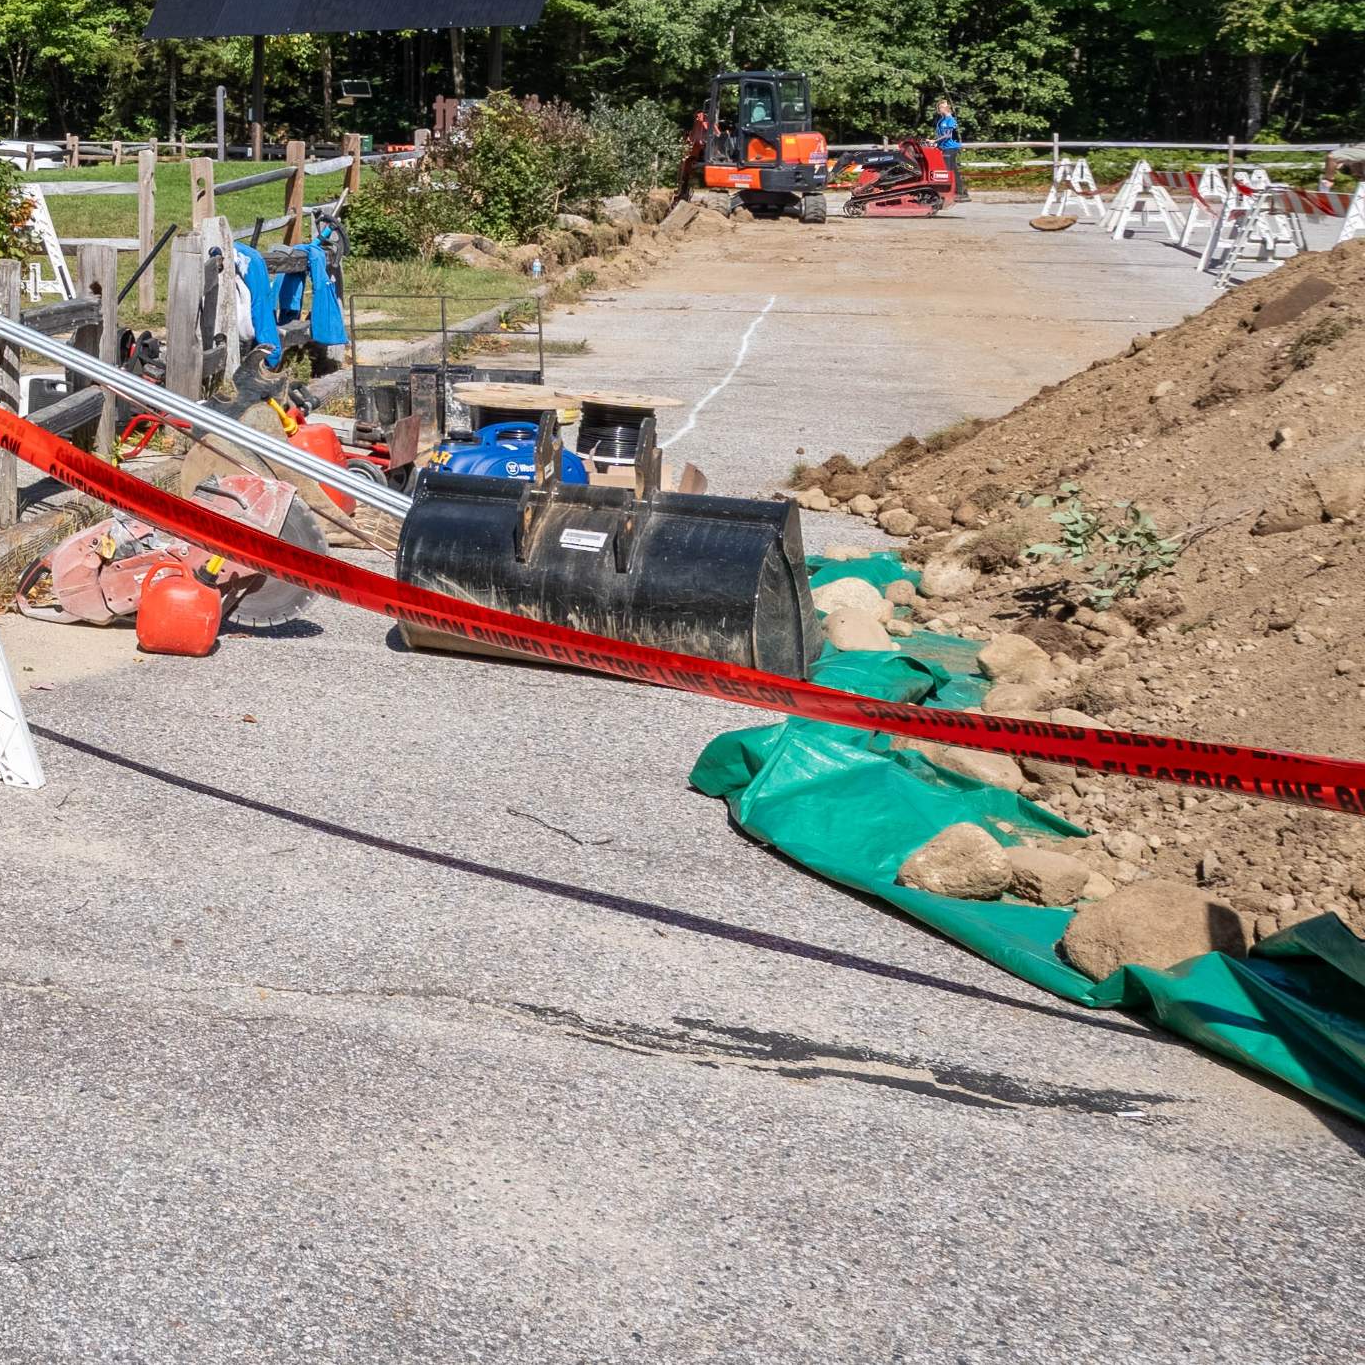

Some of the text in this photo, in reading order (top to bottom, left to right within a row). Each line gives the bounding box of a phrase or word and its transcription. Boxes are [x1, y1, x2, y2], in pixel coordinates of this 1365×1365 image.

[383, 602, 799, 708] CAUTION BURIED ELECTRIC LINE BELOW
[1252, 777, 1325, 804] LINE
